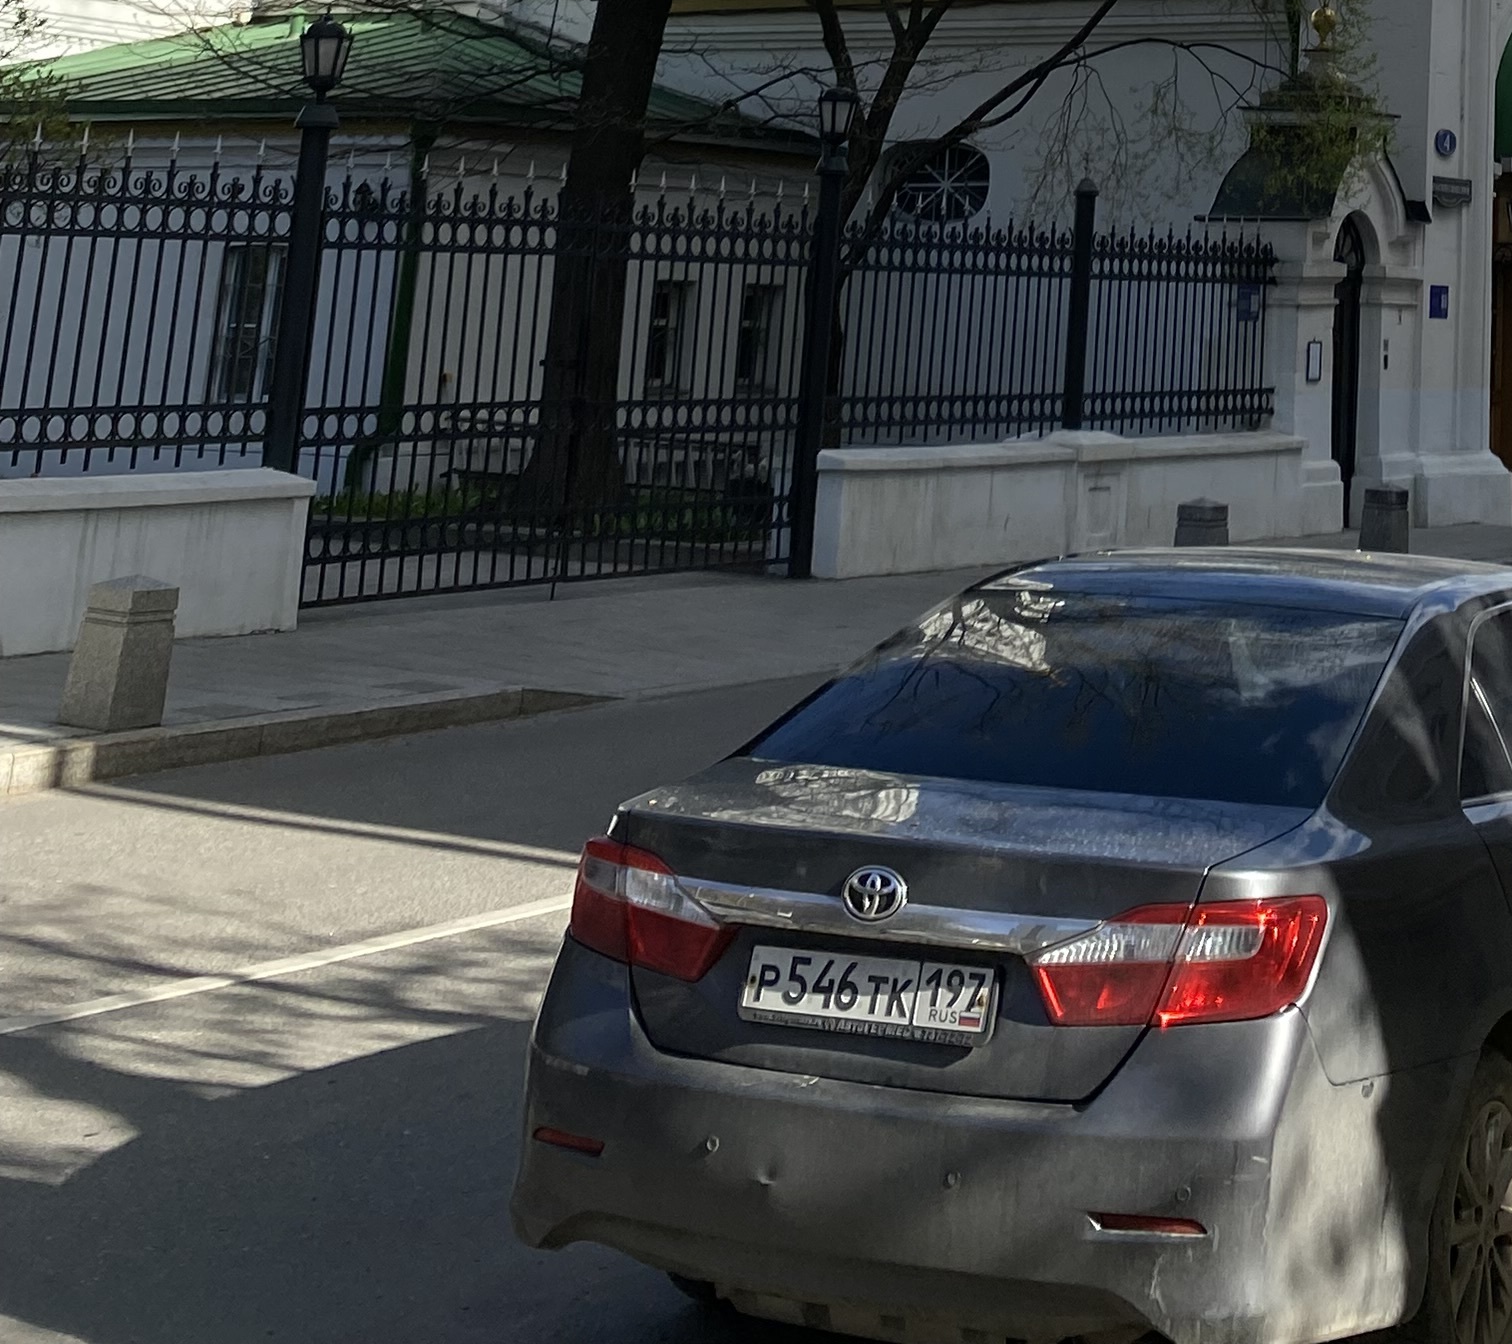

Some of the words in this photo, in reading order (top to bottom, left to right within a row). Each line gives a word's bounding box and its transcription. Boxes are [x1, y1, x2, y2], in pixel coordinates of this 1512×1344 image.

[752, 956, 913, 1018] Р546ТК
[925, 968, 986, 1012] 197
[928, 1008, 958, 1024] RUS
